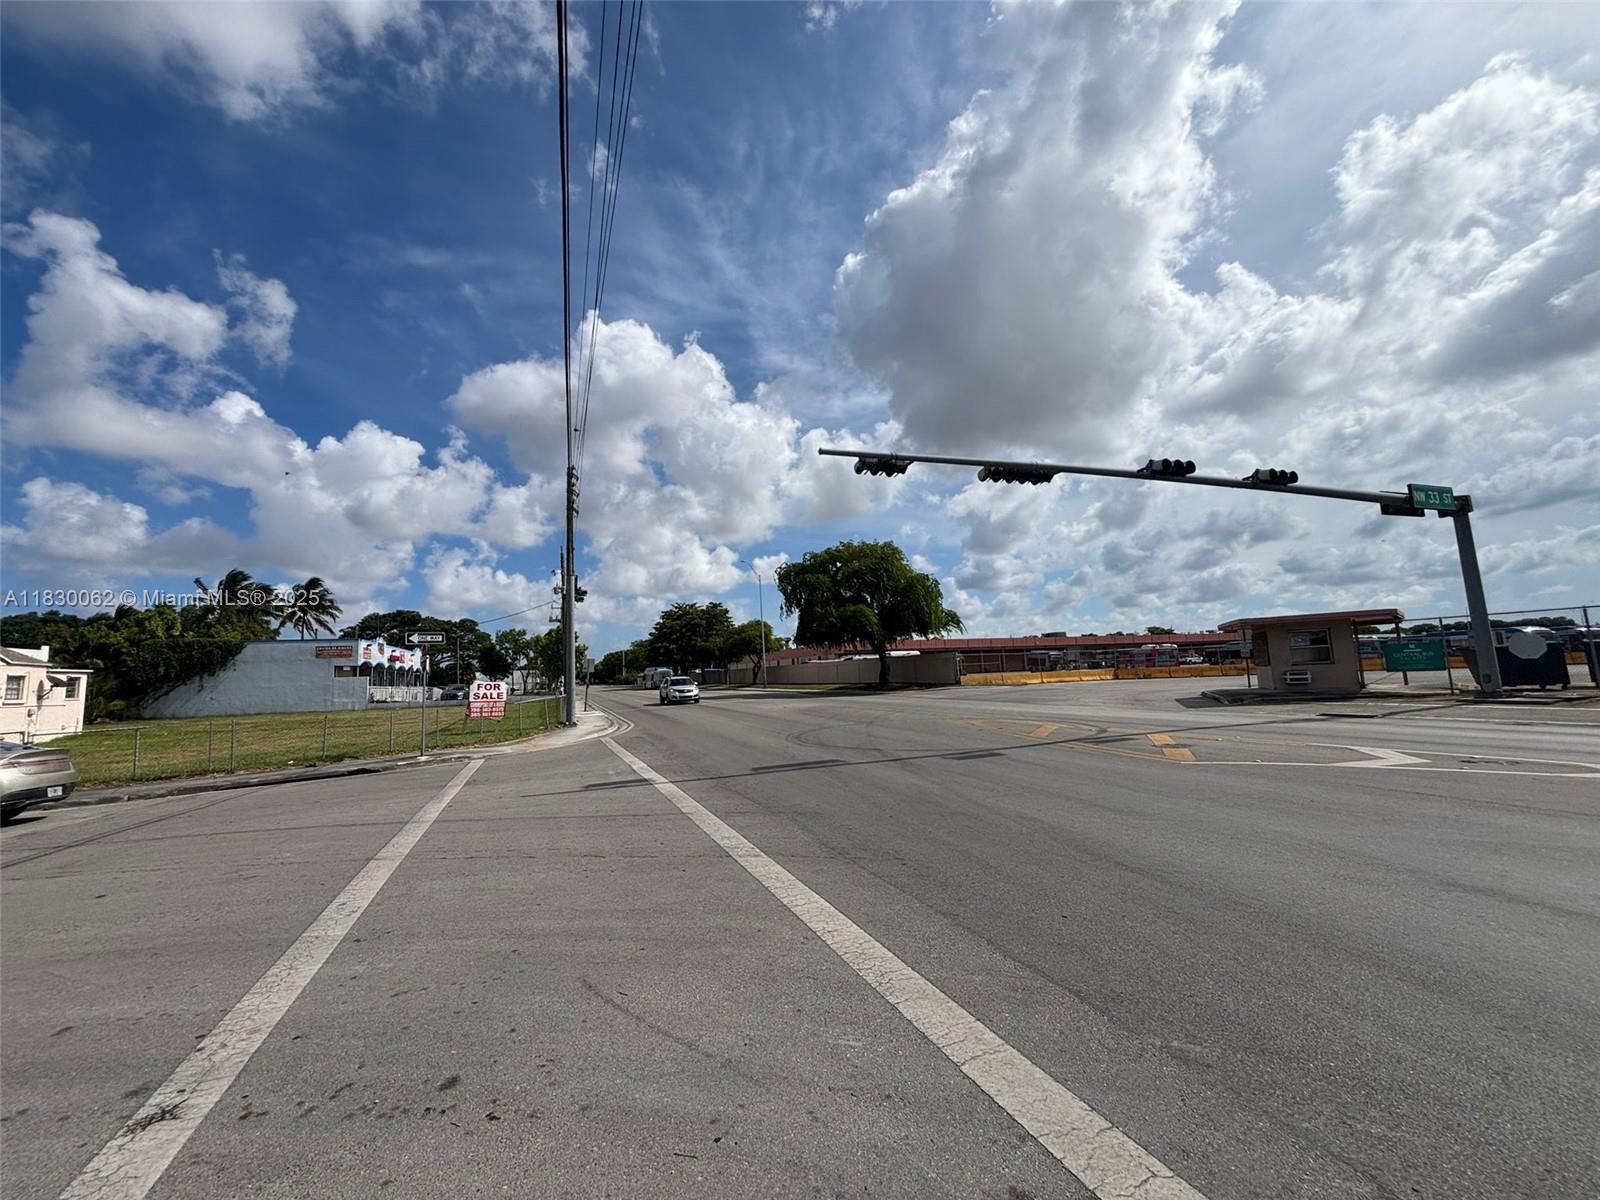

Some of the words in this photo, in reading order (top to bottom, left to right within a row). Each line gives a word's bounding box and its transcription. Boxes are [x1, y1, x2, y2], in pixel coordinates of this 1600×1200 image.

[1428, 491, 1440, 504] 33
[1443, 493, 1452, 504] ST
[477, 683, 501, 691] FOR
[473, 692, 504, 700] SALE
